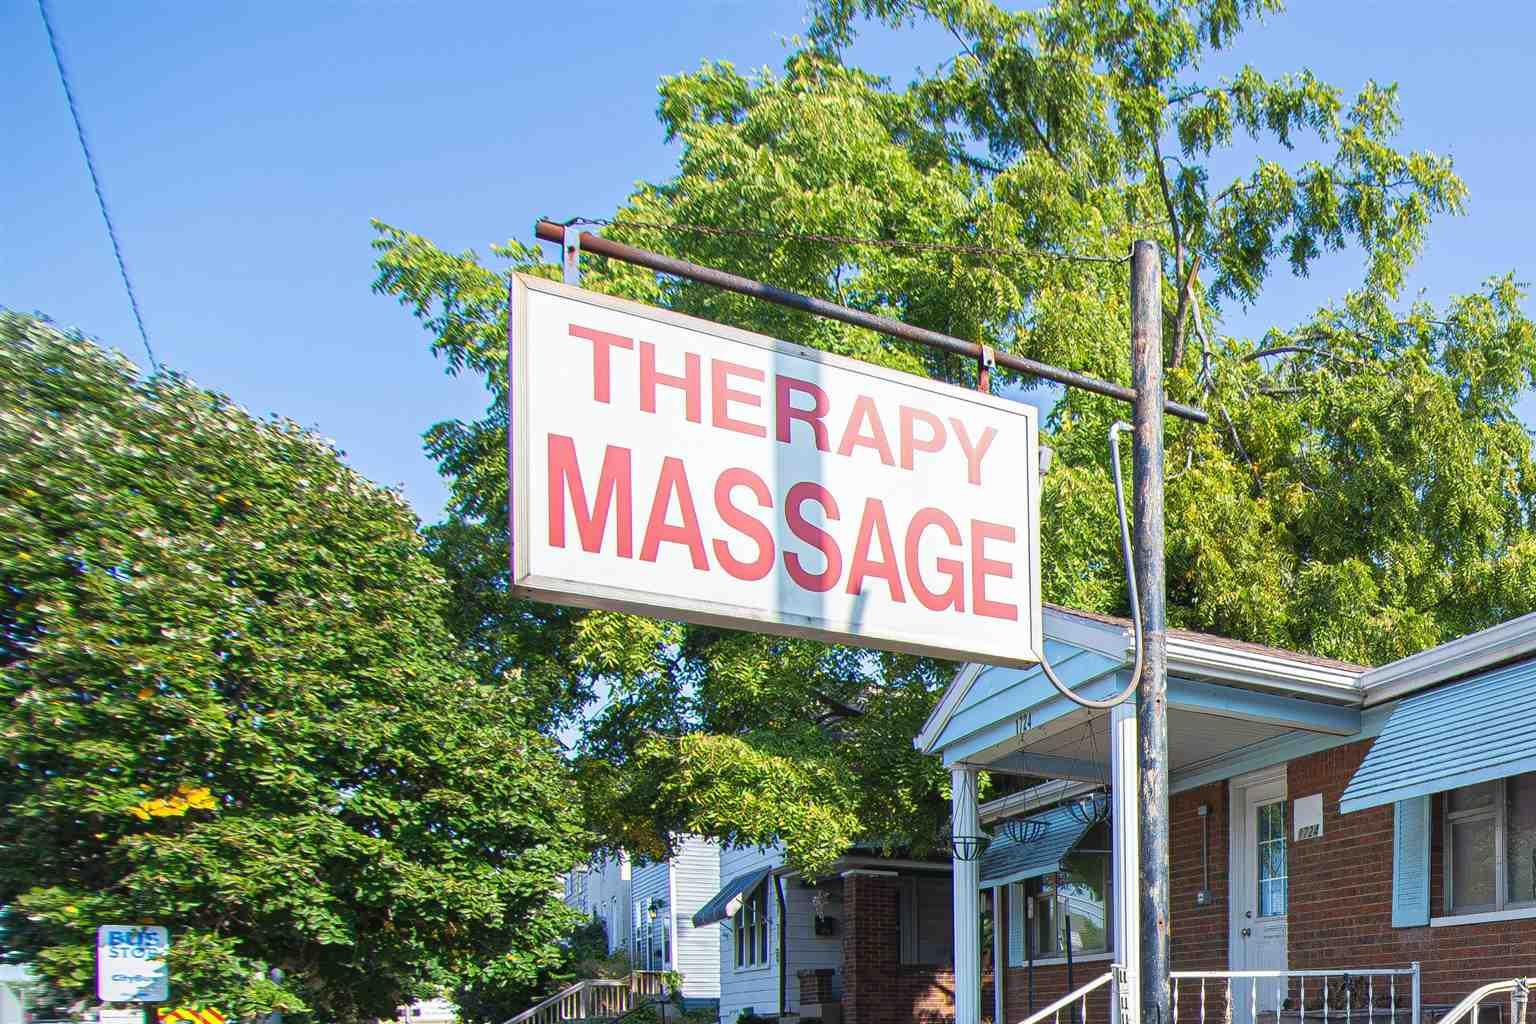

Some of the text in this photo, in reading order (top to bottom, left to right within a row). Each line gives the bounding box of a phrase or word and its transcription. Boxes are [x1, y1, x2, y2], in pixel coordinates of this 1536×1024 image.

[569, 323, 998, 486] THERAPY
[547, 432, 1018, 622] MASSAGE
[109, 931, 160, 945] BUS
[109, 947, 161, 959] STOP
